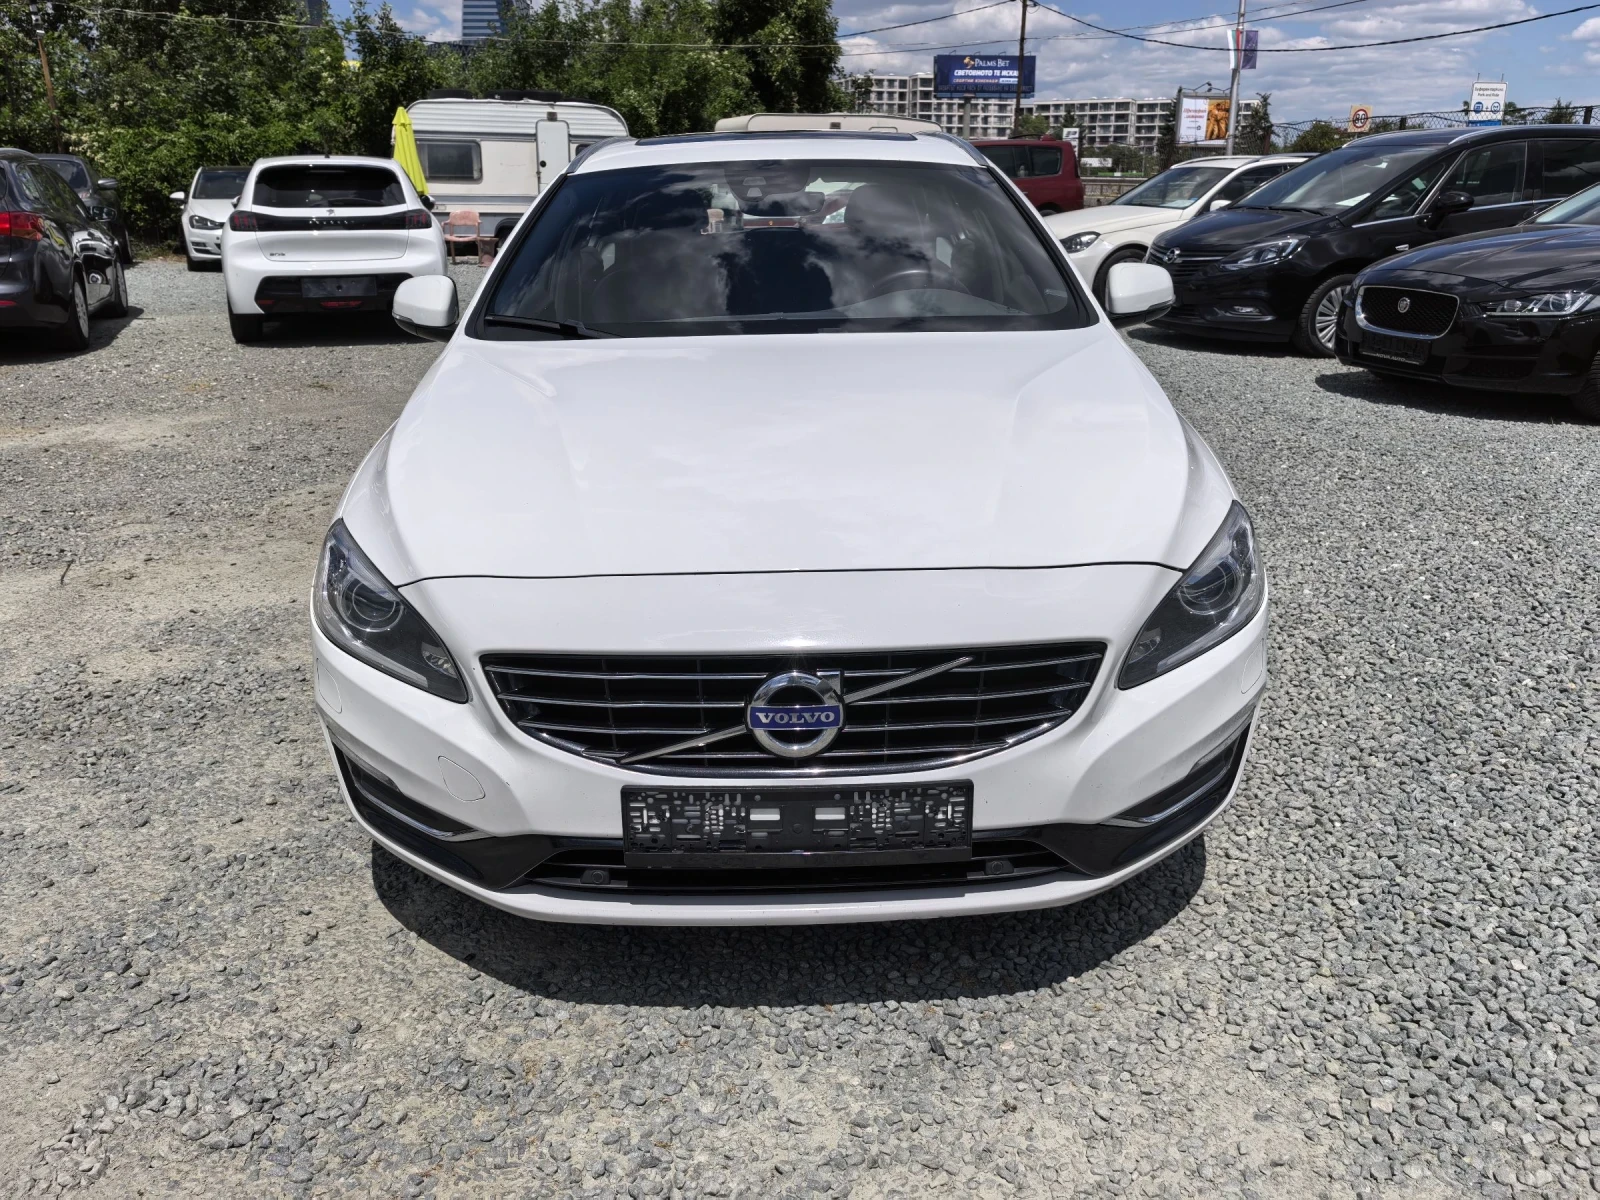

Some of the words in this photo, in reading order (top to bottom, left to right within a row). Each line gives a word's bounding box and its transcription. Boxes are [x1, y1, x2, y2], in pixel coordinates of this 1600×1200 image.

[974, 59, 996, 67] PALMS
[997, 59, 1010, 67] BET
[756, 711, 835, 724] VOLVO
